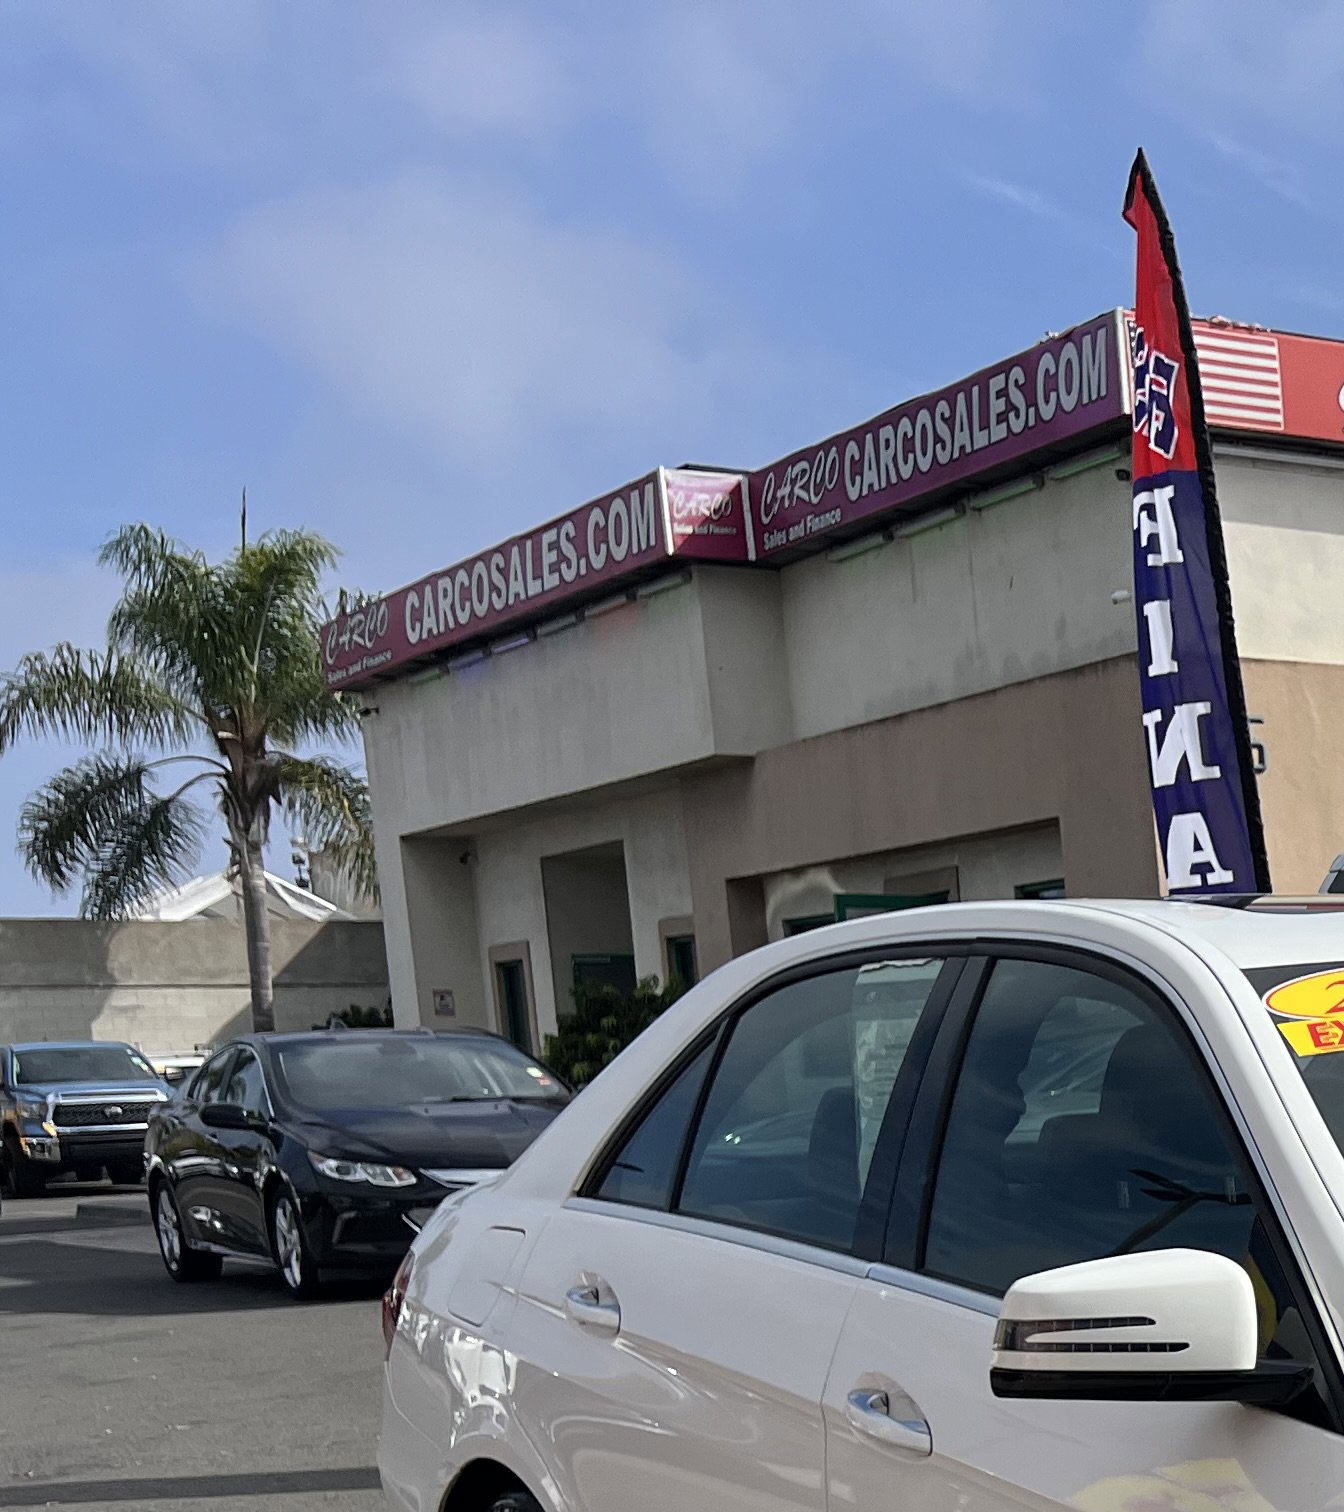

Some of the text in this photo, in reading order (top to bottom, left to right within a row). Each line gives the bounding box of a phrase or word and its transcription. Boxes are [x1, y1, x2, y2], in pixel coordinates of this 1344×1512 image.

[844, 327, 1108, 502] CARCOSALES.COM
[761, 446, 839, 525] CARCO
[404, 482, 657, 645] CARCOSALES.COM
[764, 508, 841, 551] Sales and Finance
[326, 601, 389, 665] CARCO
